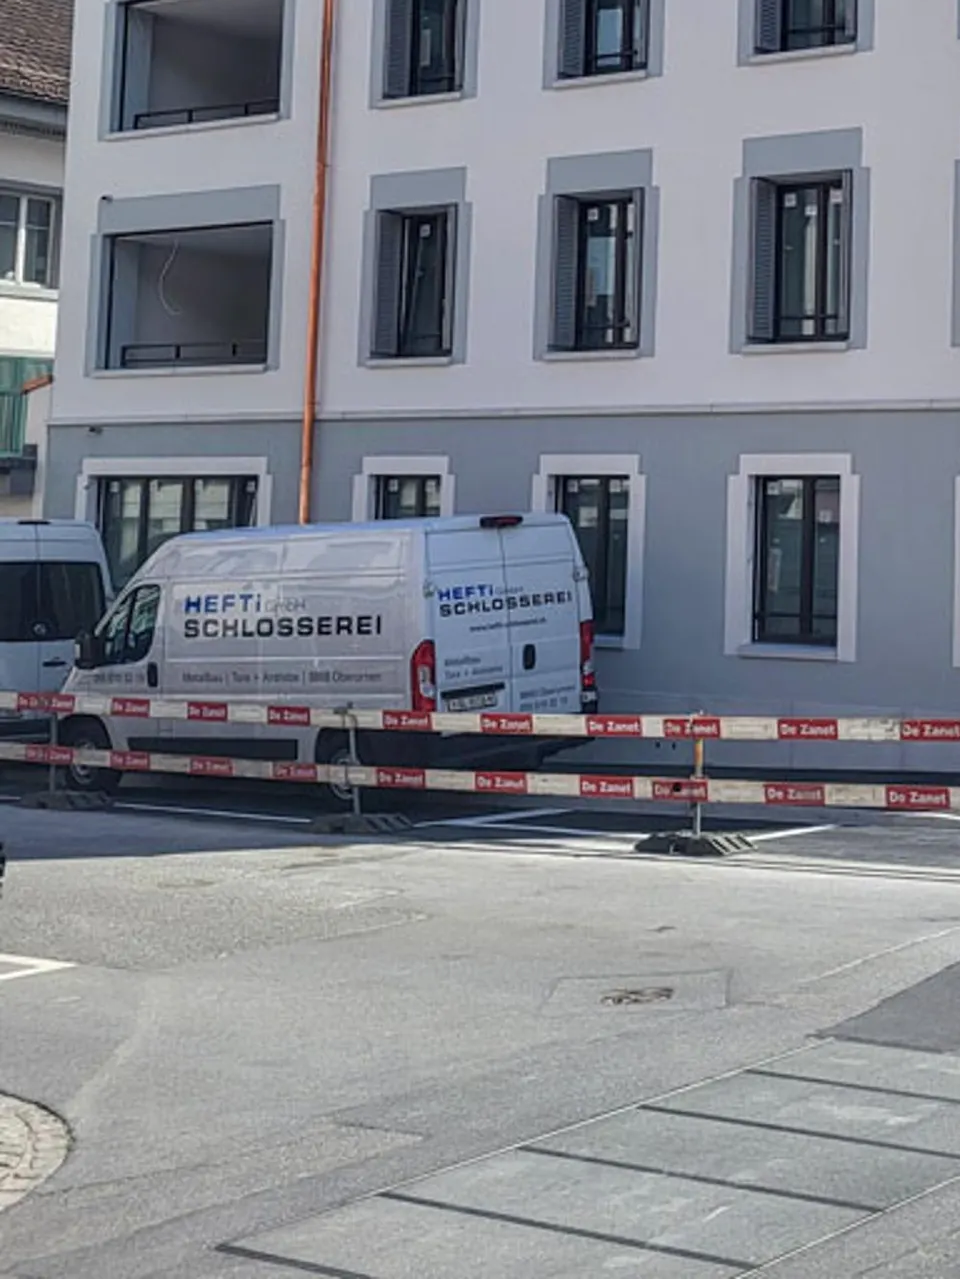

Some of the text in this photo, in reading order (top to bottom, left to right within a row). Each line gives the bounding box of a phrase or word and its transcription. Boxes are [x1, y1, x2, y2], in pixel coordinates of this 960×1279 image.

[439, 591, 572, 617] SCHLOSSEREI
[184, 615, 382, 638] SCHLOSSEREI
[590, 722, 640, 732] De Zanet
[780, 724, 836, 735] De Zanet
[902, 726, 960, 737] De Zanet
[582, 781, 632, 792] De Zanet
[767, 789, 784, 799] De
[889, 791, 947, 804] De Zanet
